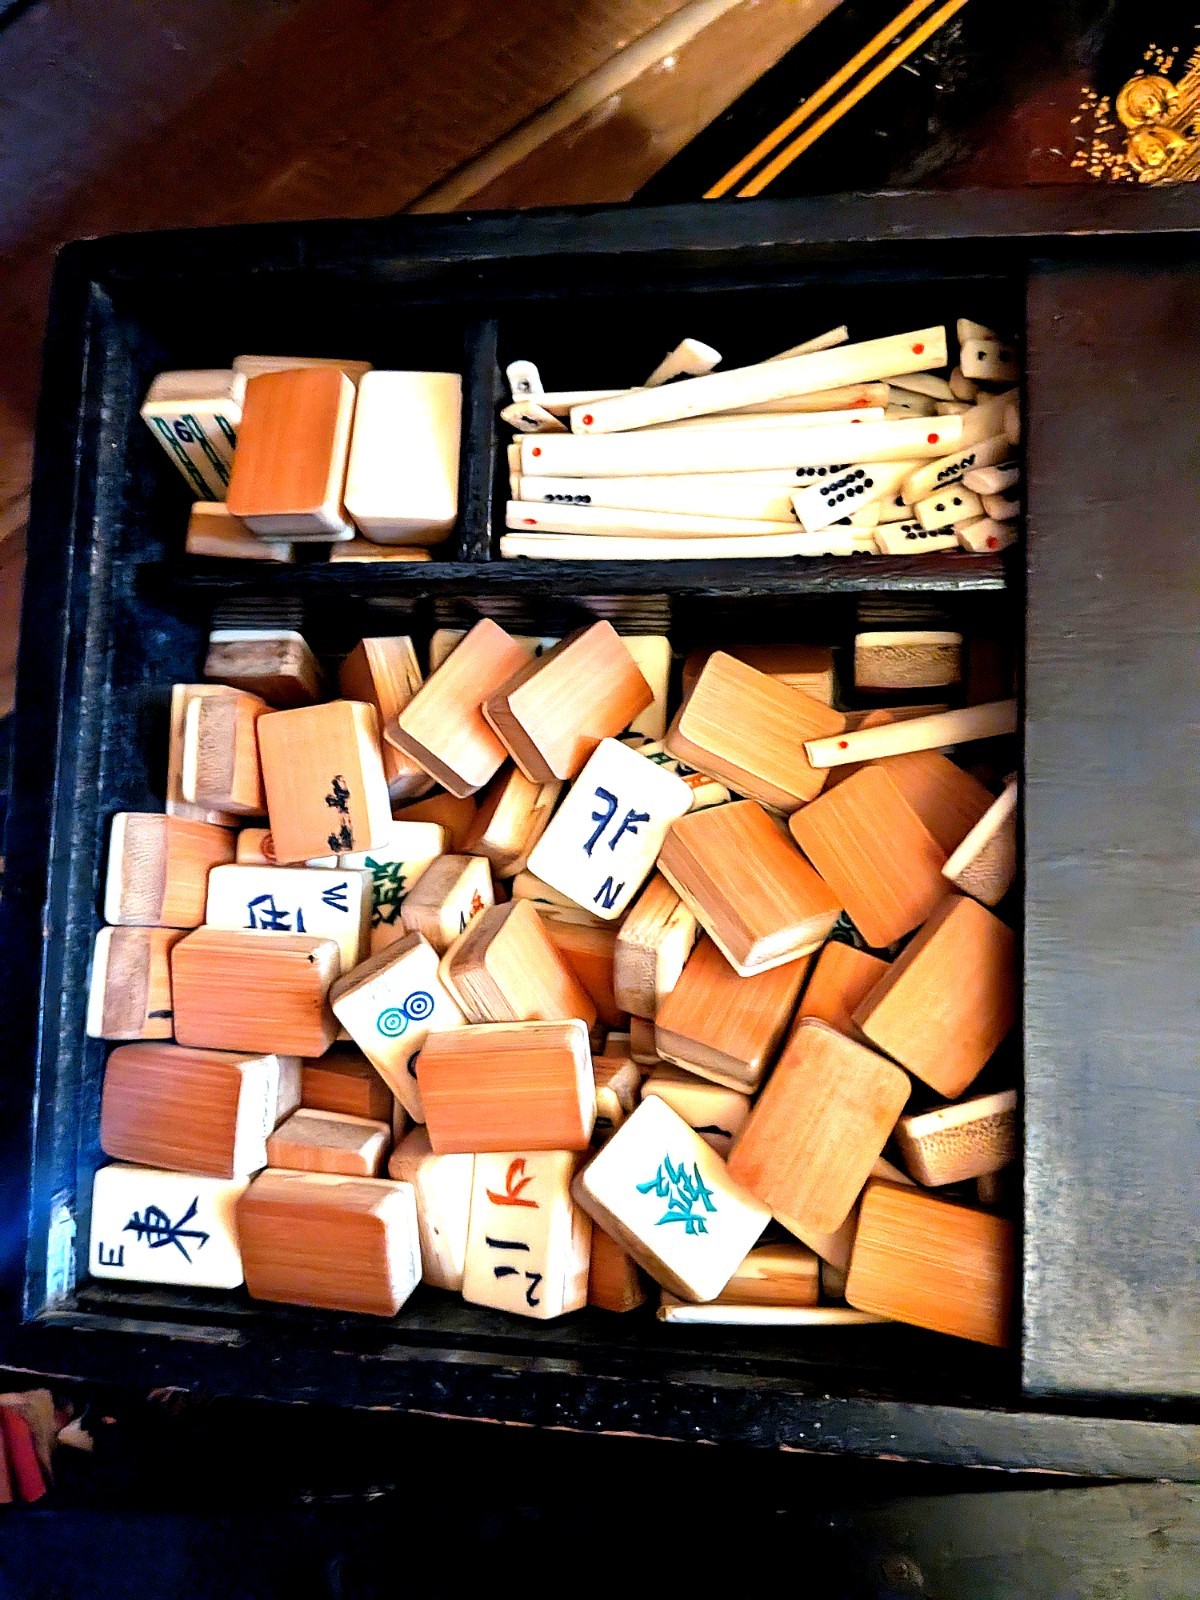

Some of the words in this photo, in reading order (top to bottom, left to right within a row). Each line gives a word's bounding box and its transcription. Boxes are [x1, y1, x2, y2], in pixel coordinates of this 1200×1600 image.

[582, 786, 651, 858] 北
[322, 882, 349, 913] W
[593, 876, 625, 909] N
[122, 1195, 210, 1264] 東
[99, 1241, 124, 1267] E
[524, 1271, 542, 1306] 2
